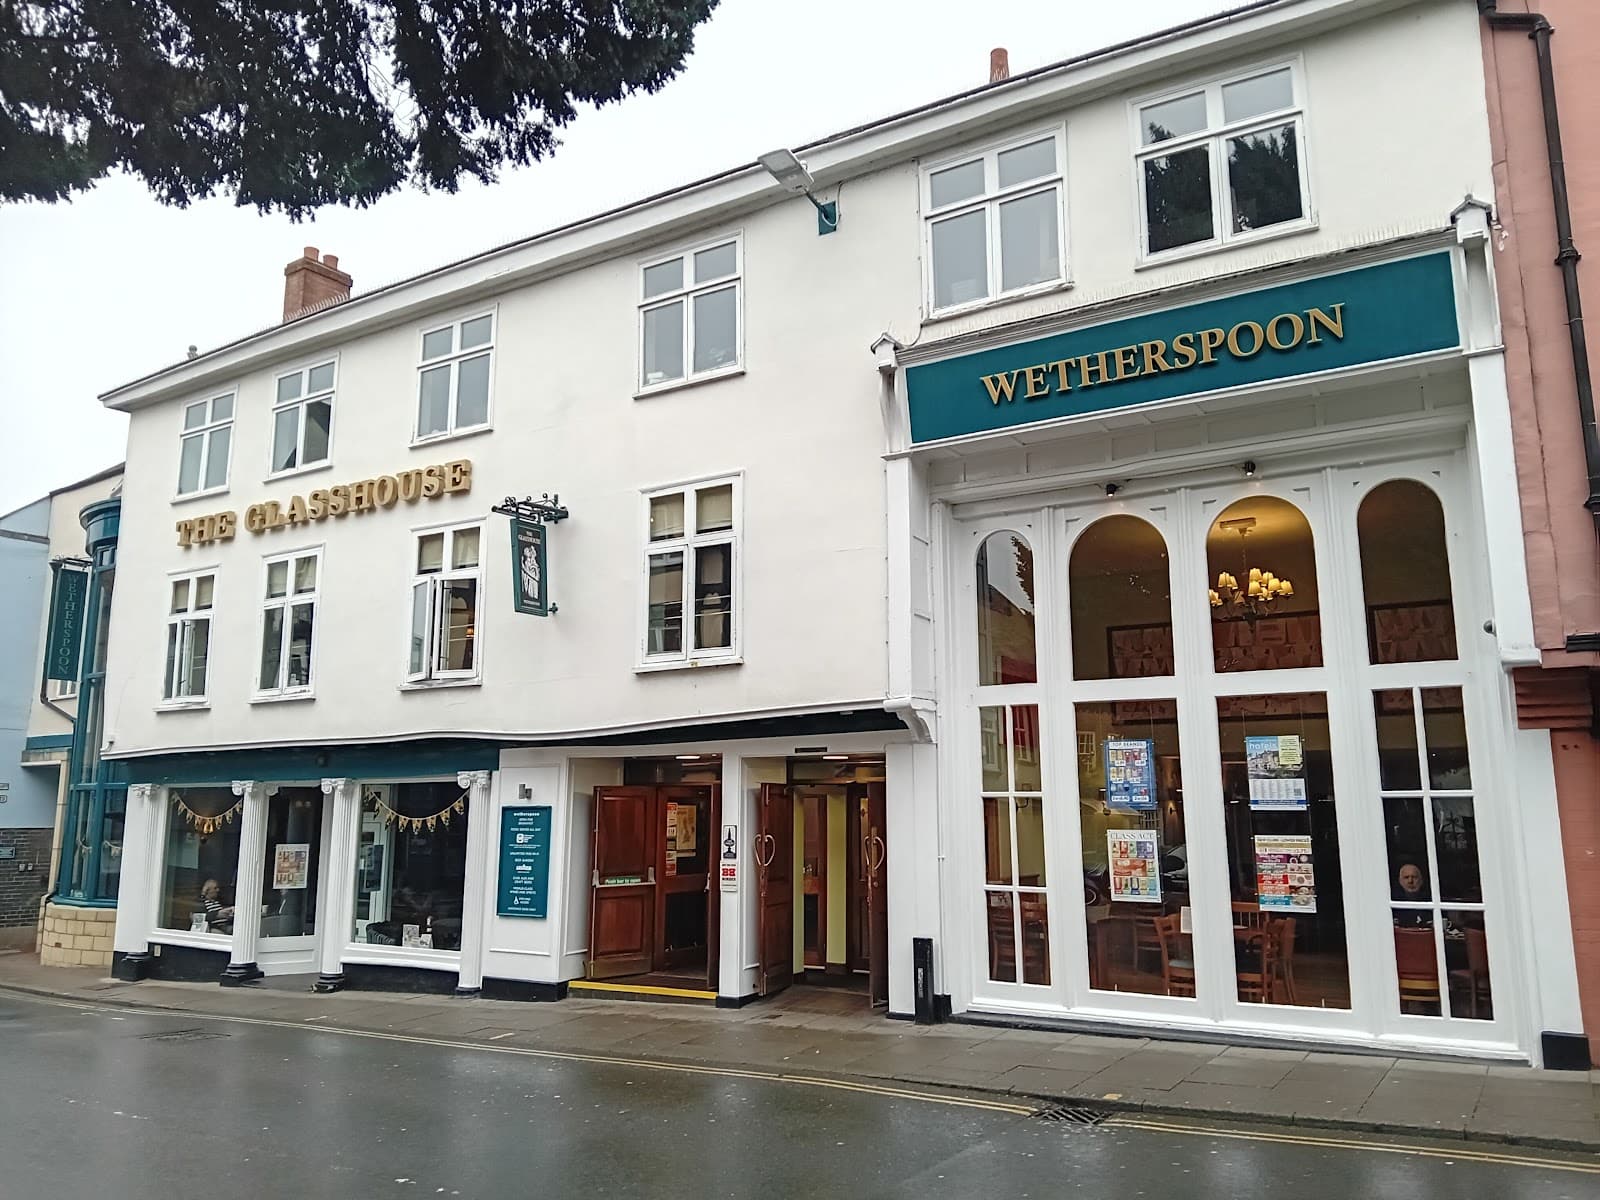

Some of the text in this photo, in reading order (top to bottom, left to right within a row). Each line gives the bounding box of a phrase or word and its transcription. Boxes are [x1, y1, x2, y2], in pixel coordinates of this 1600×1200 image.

[980, 302, 1345, 404] WETHERSPOON
[176, 458, 472, 547] THE GLASSHOUSE
[58, 574, 79, 675] WETHERSPOON
